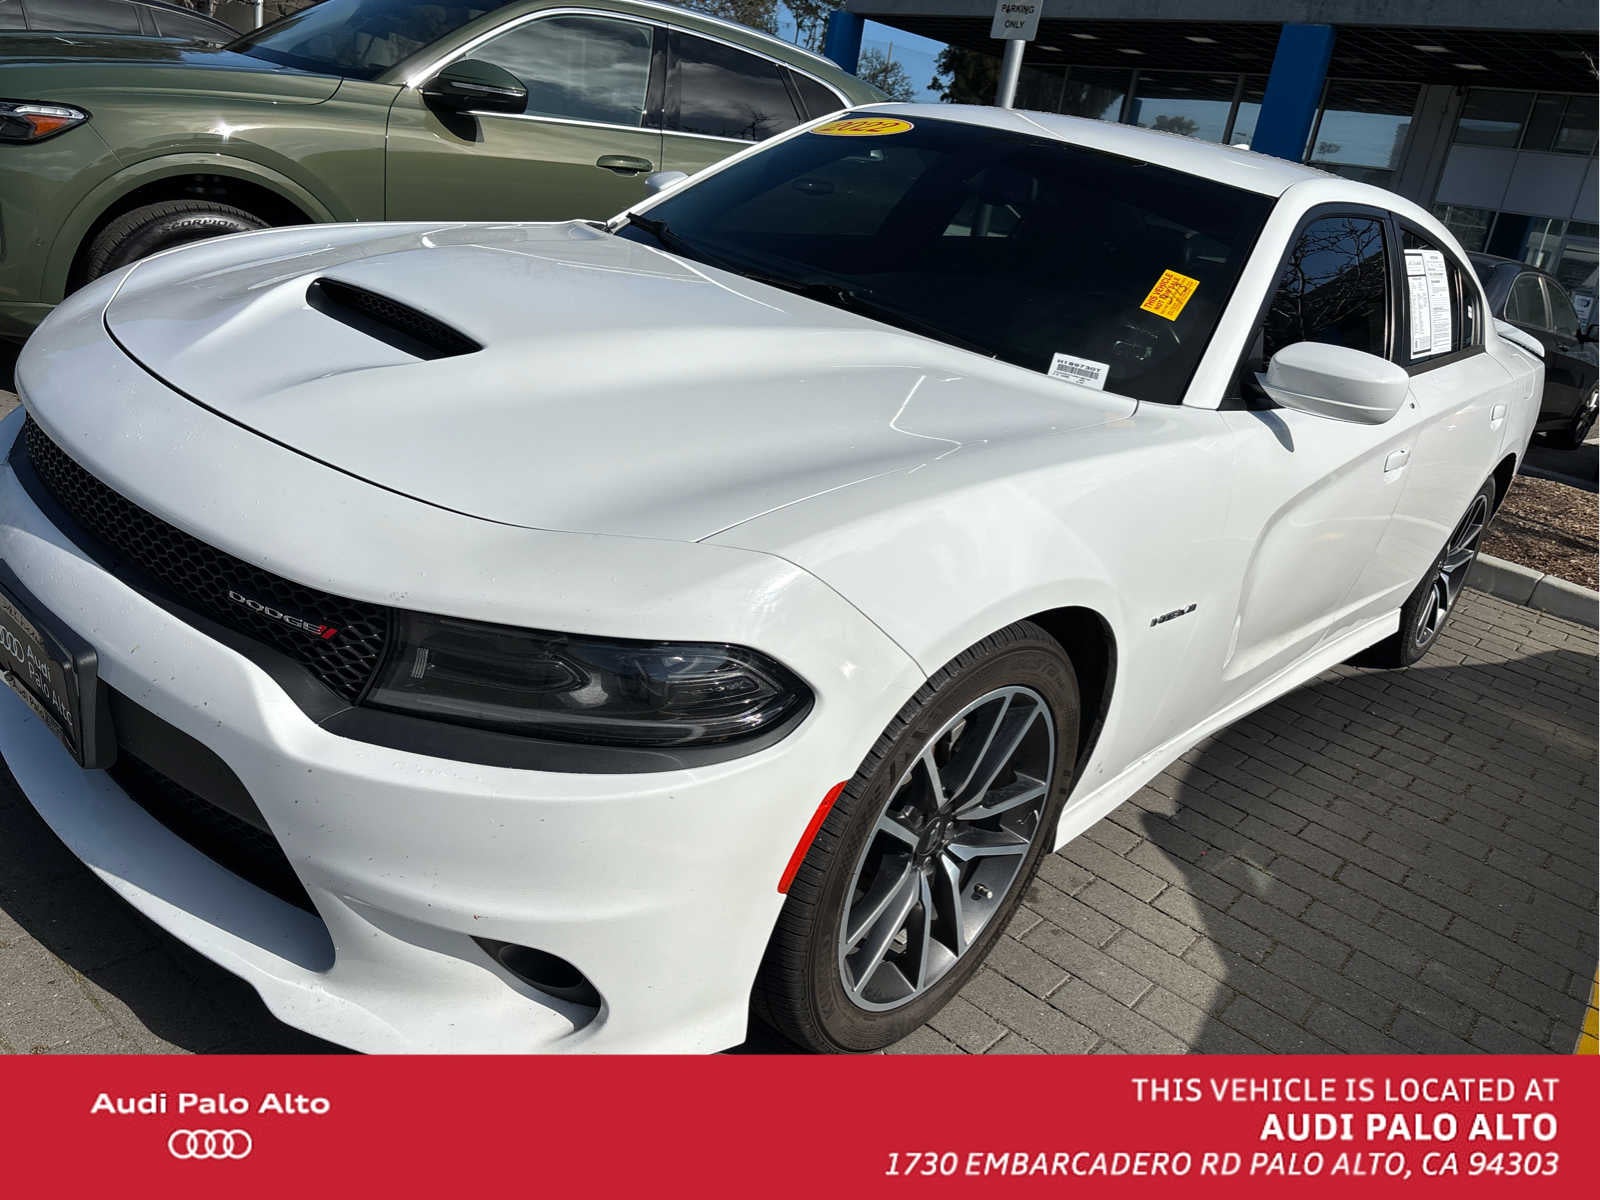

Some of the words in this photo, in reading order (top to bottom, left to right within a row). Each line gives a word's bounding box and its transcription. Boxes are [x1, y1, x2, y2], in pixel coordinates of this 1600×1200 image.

[1001, 4, 1035, 15] PARKING
[1004, 20, 1025, 28] ONLY
[820, 121, 900, 132] 2022
[1152, 272, 1173, 296] VEHICLE
[229, 590, 321, 635] DODGE
[27, 645, 51, 682] Audi
[28, 661, 50, 698] Palo
[52, 689, 73, 726] Alto
